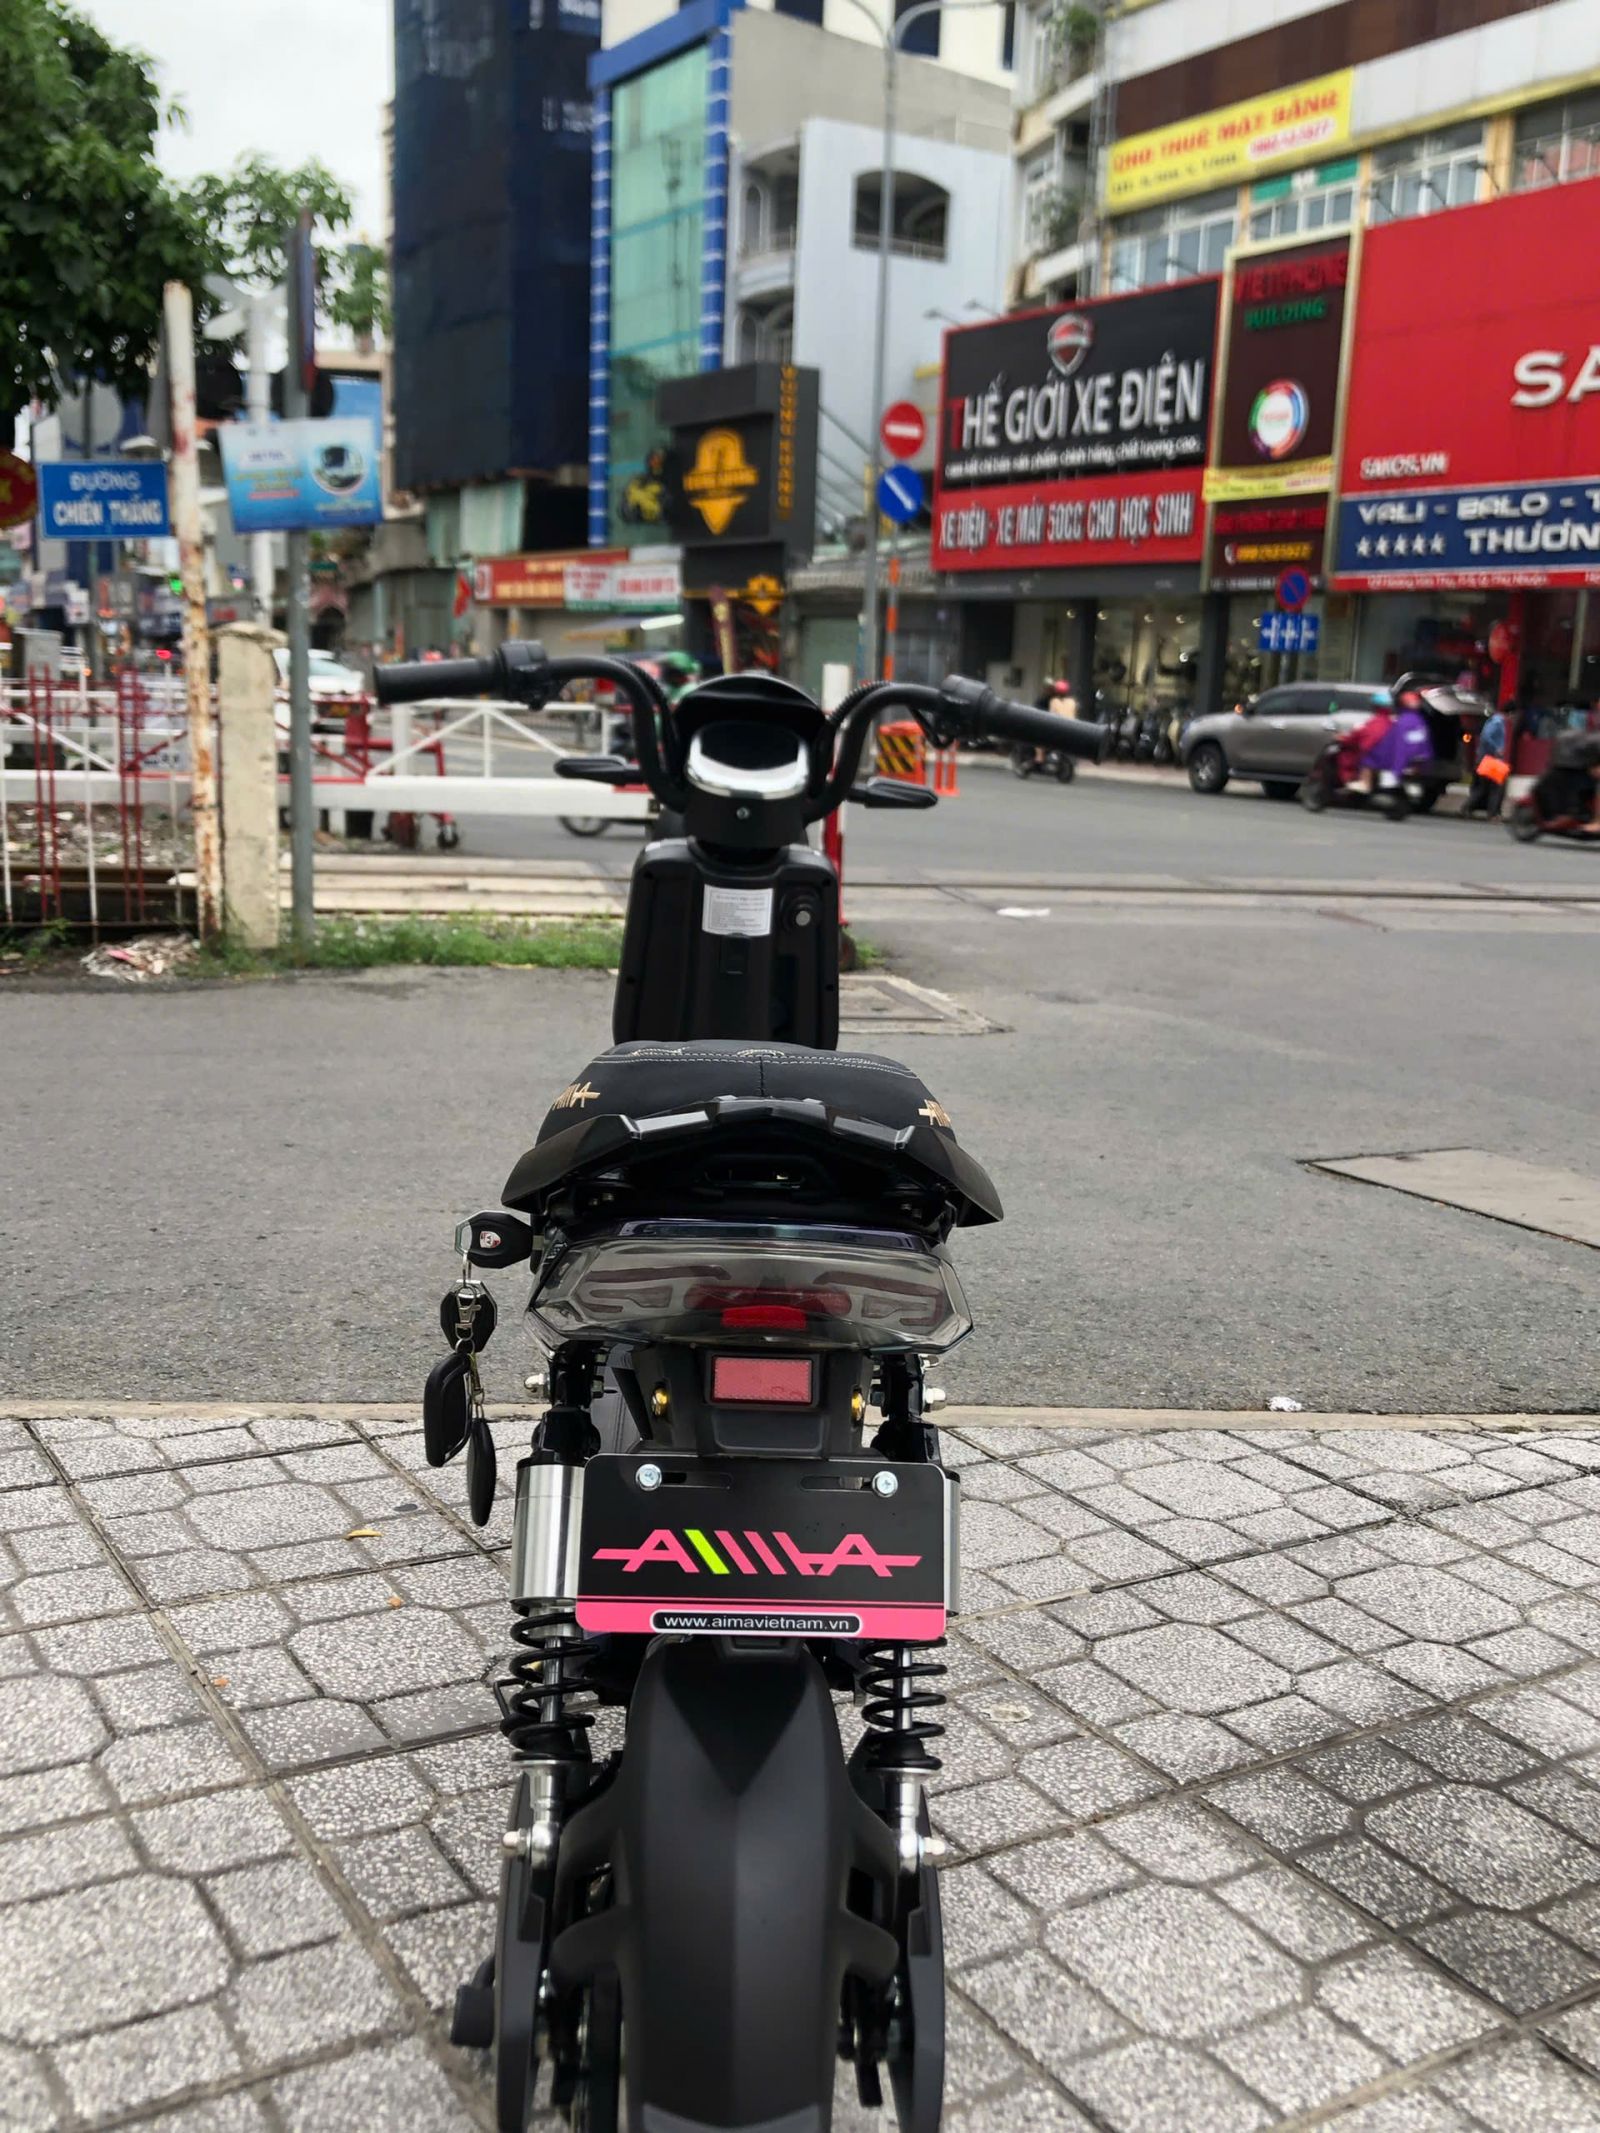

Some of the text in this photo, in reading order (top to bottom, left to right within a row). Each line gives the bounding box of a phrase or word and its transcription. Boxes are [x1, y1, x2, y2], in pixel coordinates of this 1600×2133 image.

[1072, 371, 1116, 436] XE
[1118, 349, 1205, 434] ĐIỆN
[940, 510, 956, 549] XE
[996, 505, 1015, 545] XE
[1016, 496, 1044, 543] MÁY
[1047, 501, 1083, 541] 50CC
[1087, 498, 1115, 540] CHO
[1119, 497, 1149, 545] HỌC
[1154, 493, 1193, 537] SINH
[1359, 500, 1427, 525] VALI
[1457, 491, 1550, 521] BALO
[664, 1614, 849, 1632] www.aimavietnam.vn
